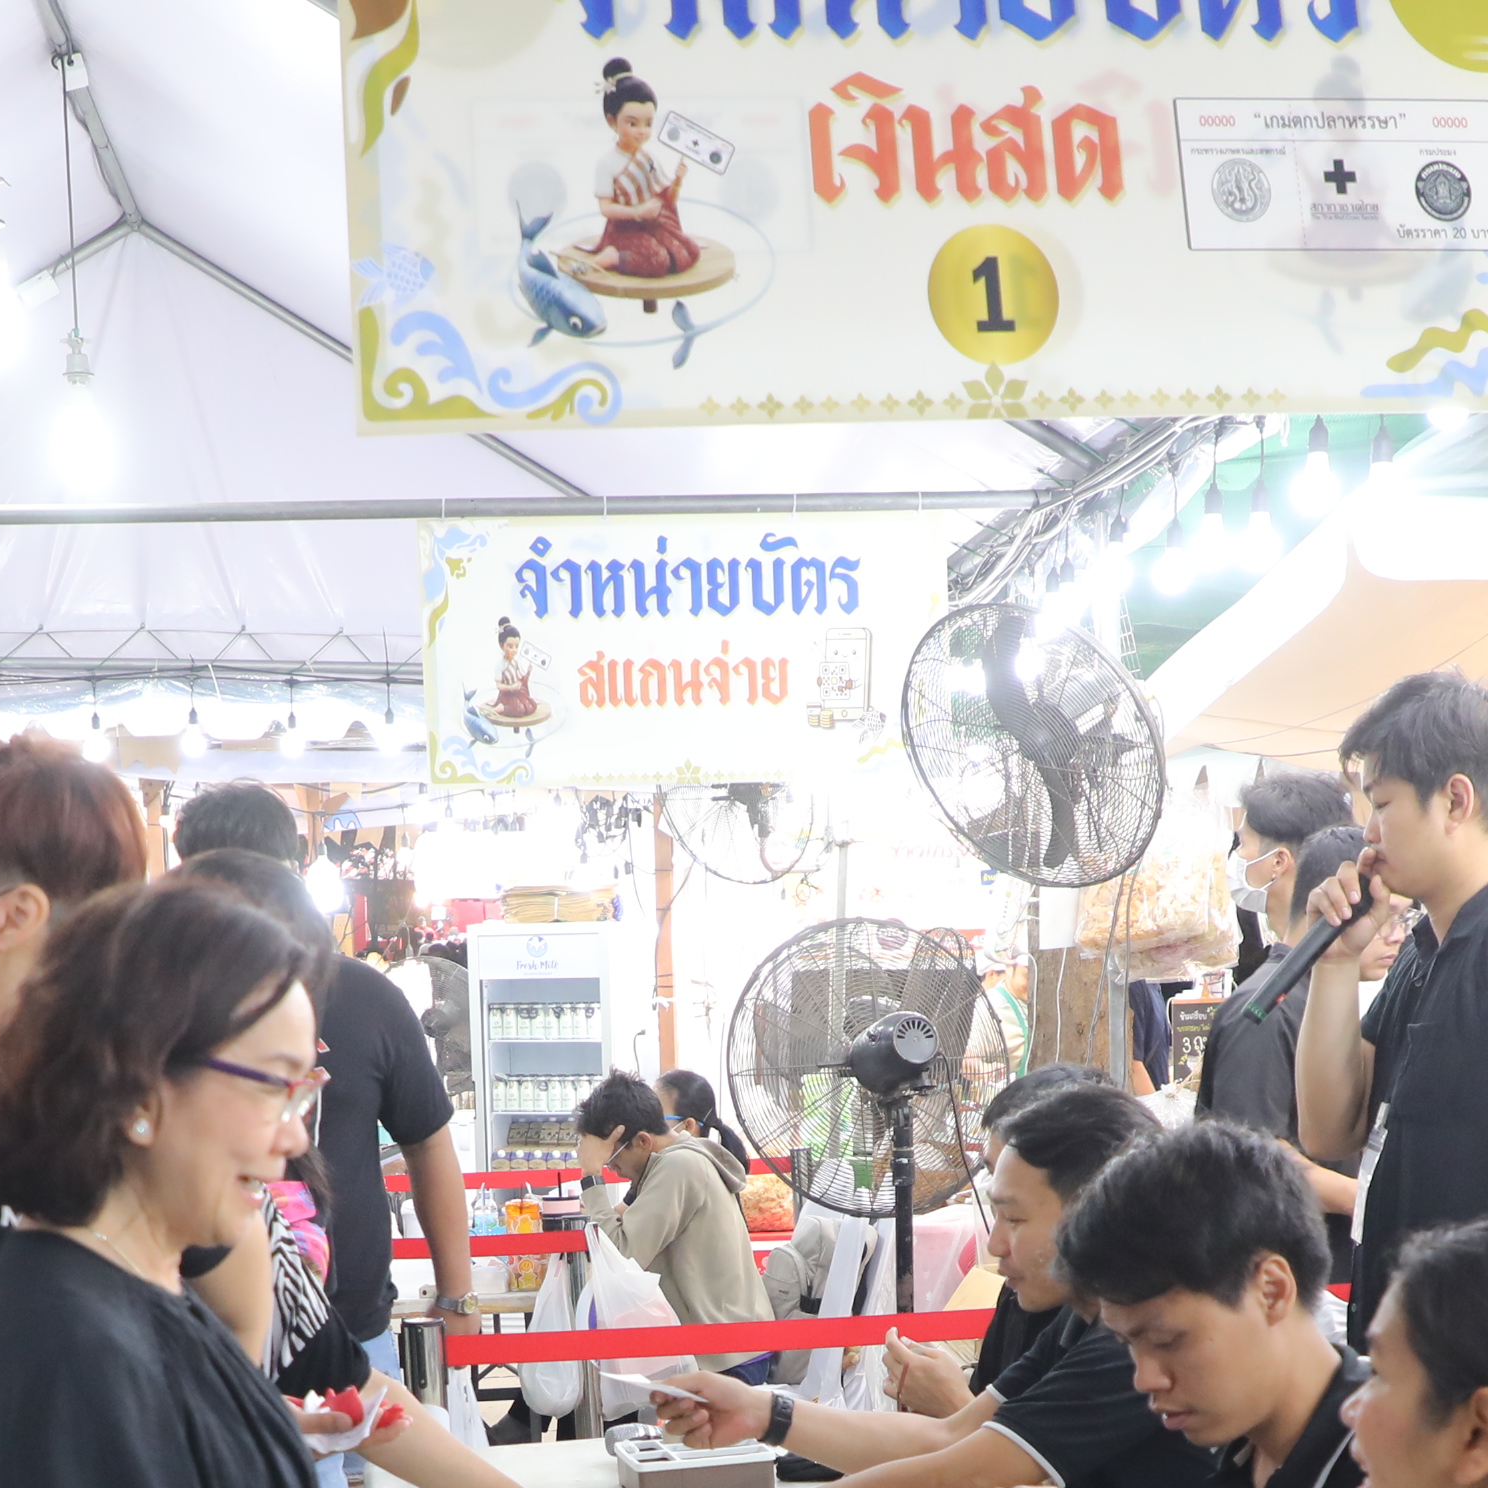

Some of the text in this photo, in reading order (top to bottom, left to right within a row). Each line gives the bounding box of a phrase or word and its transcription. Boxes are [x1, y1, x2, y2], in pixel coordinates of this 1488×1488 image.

[1199, 114, 1236, 128] 00000
[1432, 115, 1468, 129] 00000
[809, 70, 1125, 207] เงินสด
[1396, 224, 1448, 240] บัตรราคา
[1453, 227, 1466, 240] 20
[974, 254, 1015, 333] 1
[514, 532, 861, 618] จำหน่ายบัตร
[577, 639, 789, 708] สแกนจ่าย
[516, 960, 558, 970] Fresh Milk
[1182, 1036, 1191, 1054] 3
